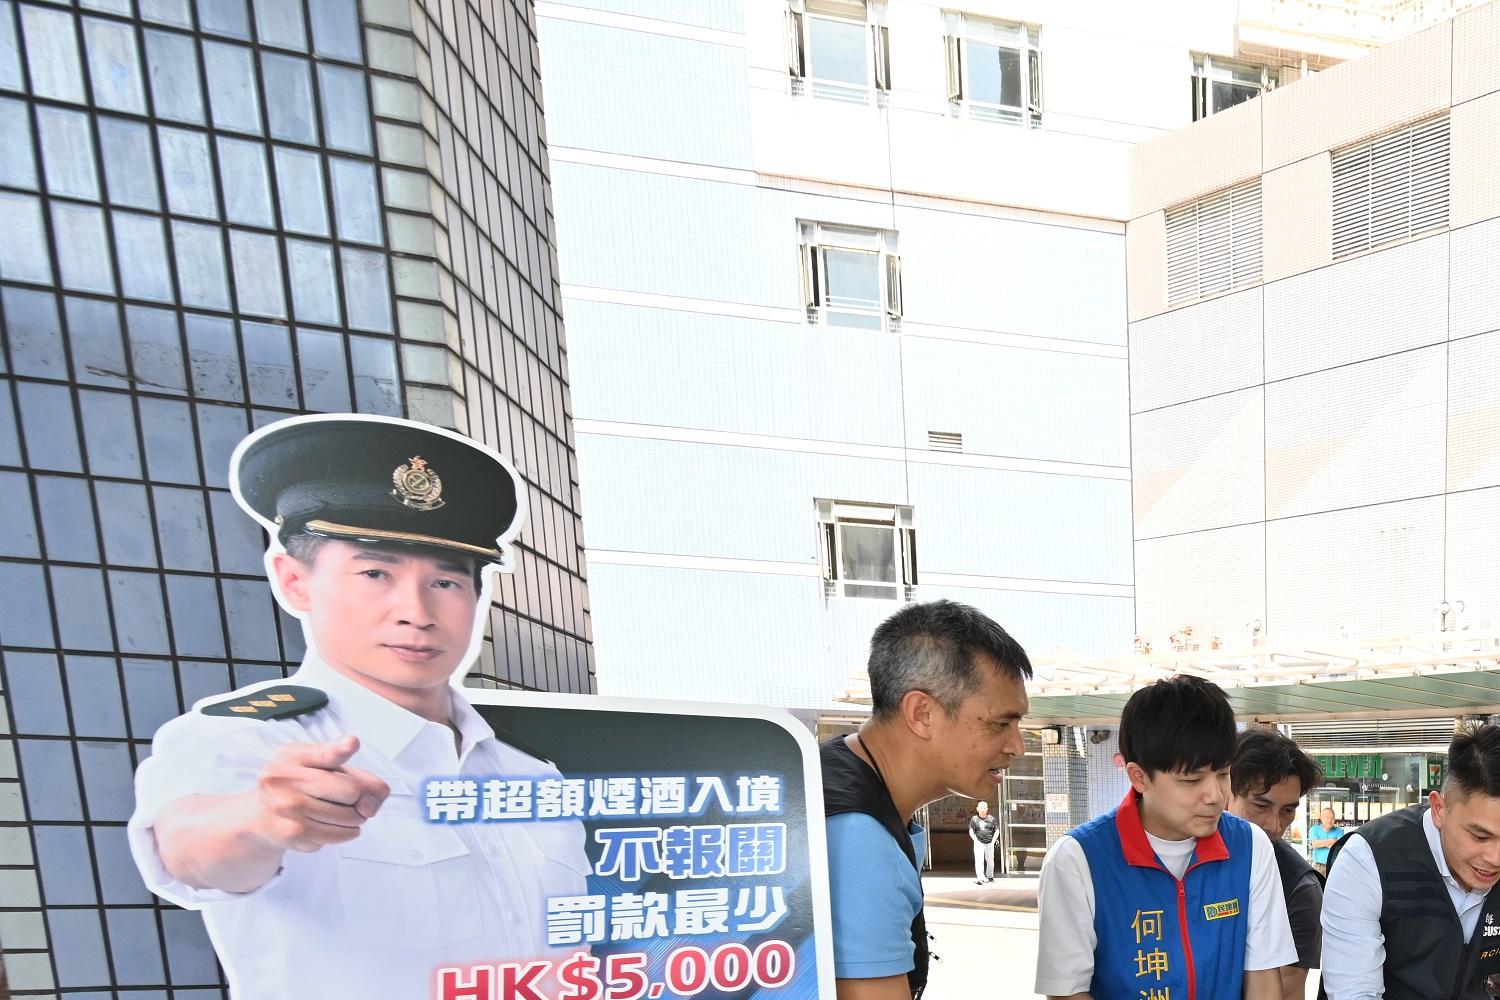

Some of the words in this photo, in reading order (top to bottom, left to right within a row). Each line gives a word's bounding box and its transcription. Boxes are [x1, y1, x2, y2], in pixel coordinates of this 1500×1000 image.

[426, 775, 780, 820] 帶超額煙酒入境
[596, 824, 786, 880] 不報關
[548, 886, 787, 944] 罰款最少
